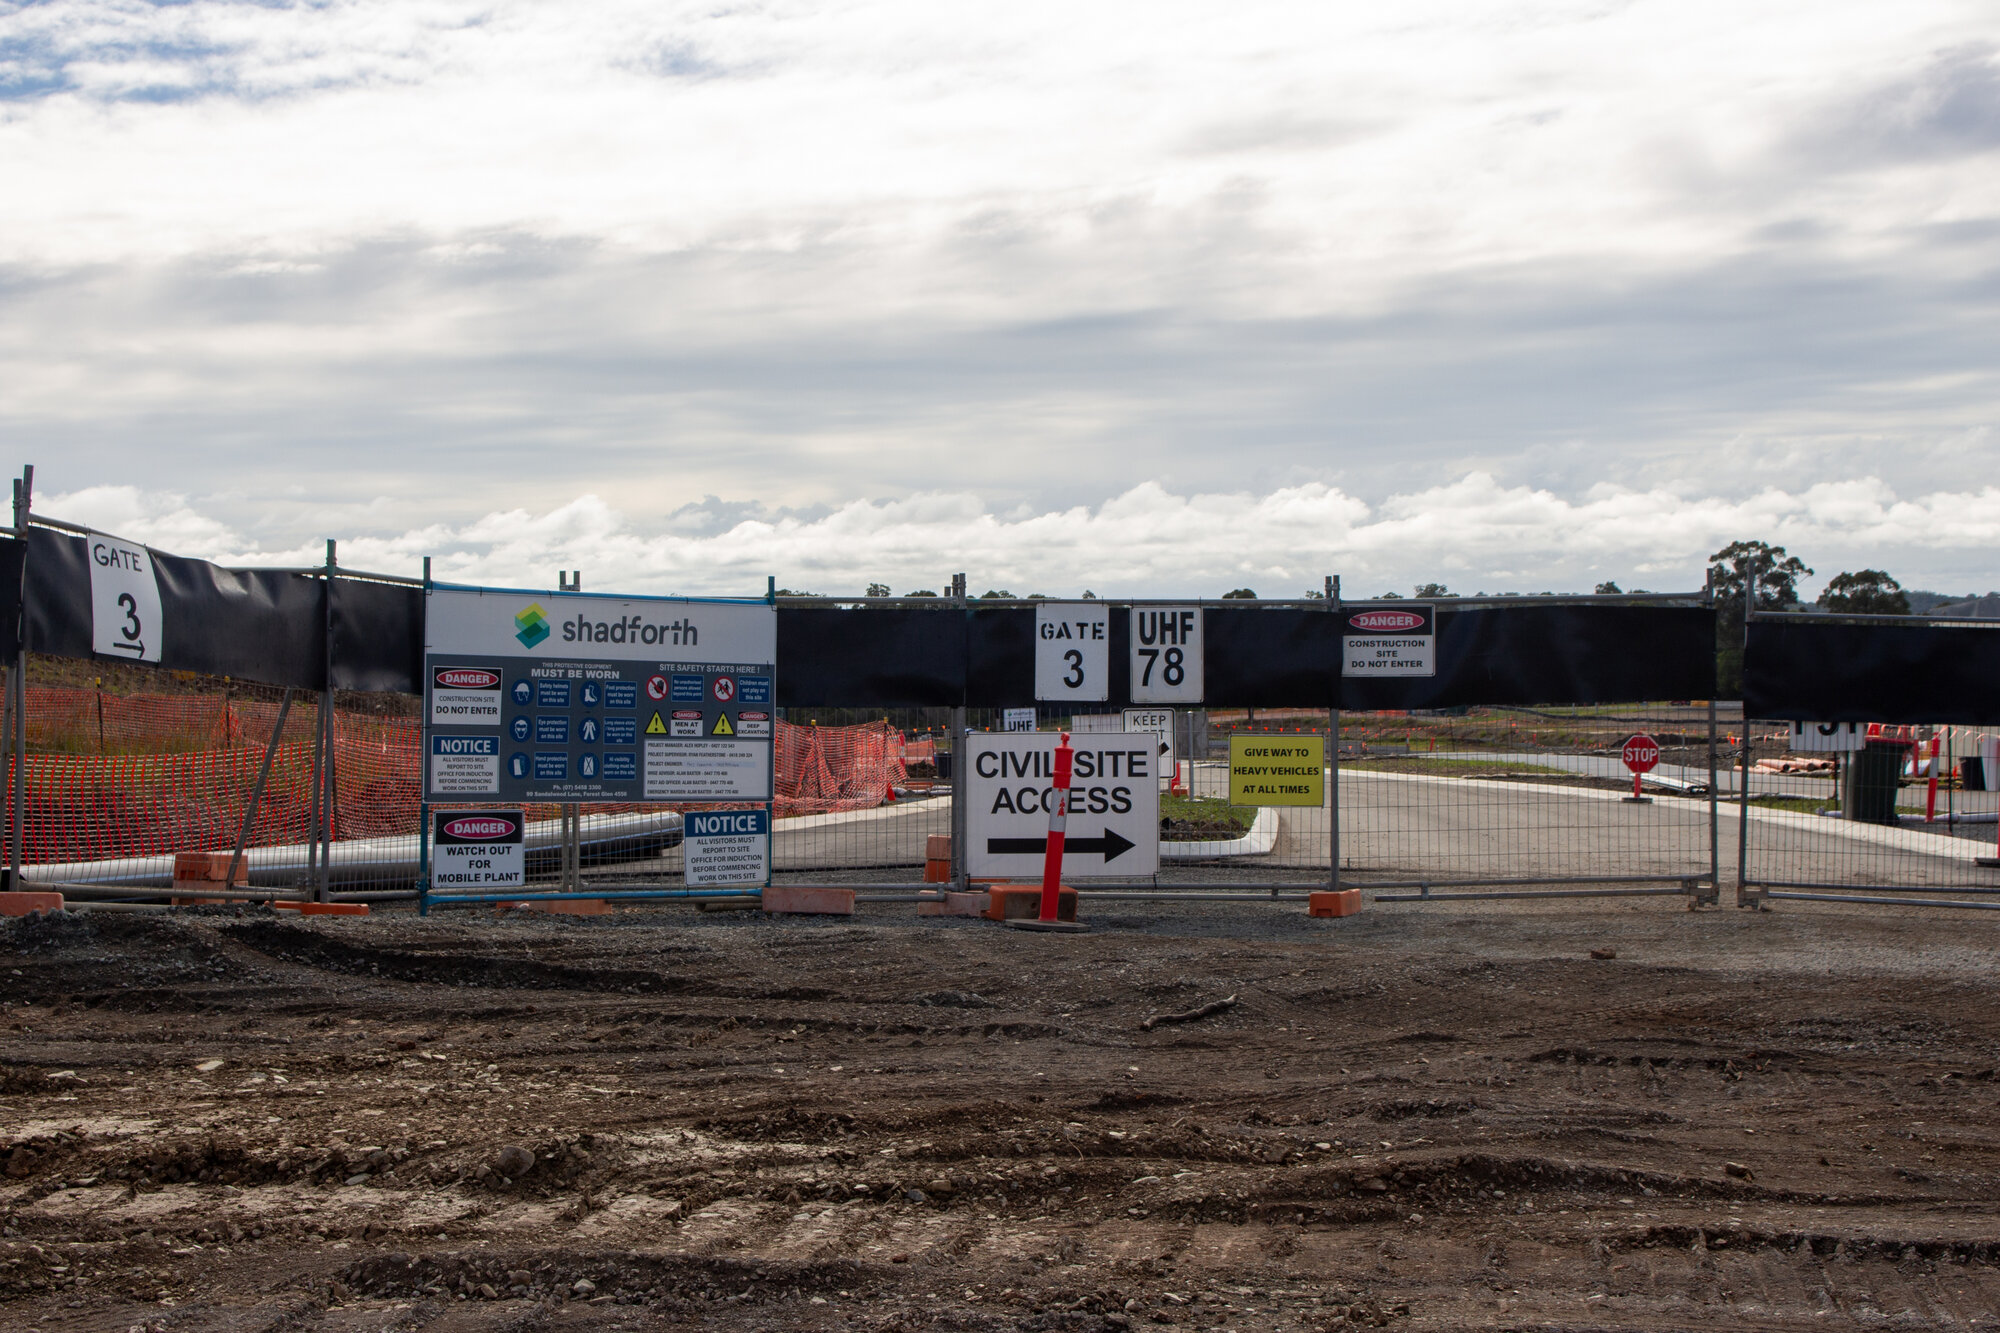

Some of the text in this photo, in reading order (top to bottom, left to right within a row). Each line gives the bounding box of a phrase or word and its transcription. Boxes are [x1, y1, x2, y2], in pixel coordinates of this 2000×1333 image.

[94, 544, 142, 572] GATE
[118, 592, 141, 640] 3
[1360, 616, 1413, 626] DANGER
[562, 614, 698, 646] shadforth
[1041, 622, 1104, 640] GATE
[1139, 612, 1194, 645] UHF
[676, 664, 705, 672] SAFETY
[1063, 649, 1084, 688] 3
[1138, 647, 1184, 686] 78
[446, 674, 490, 683] DANGER
[531, 669, 619, 679] MUST BE WORN
[436, 706, 449, 714] DO
[451, 706, 468, 714] NOT
[1133, 715, 1166, 725] KEEP
[1008, 720, 1032, 732] UHF
[441, 740, 491, 752] NOTICE
[1244, 748, 1268, 756] GIVE
[1625, 748, 1657, 762] STOP
[976, 751, 1148, 778] CIVIL SITE
[1234, 767, 1319, 775] HEAVY VEHICLES
[454, 823, 506, 834] DANGER
[694, 815, 757, 833] NOTICE
[447, 846, 512, 856] WATCH OUT
[469, 860, 490, 868] FOR
[691, 856, 712, 864] OFFICE
[437, 872, 519, 883] MOBILE PLANT
